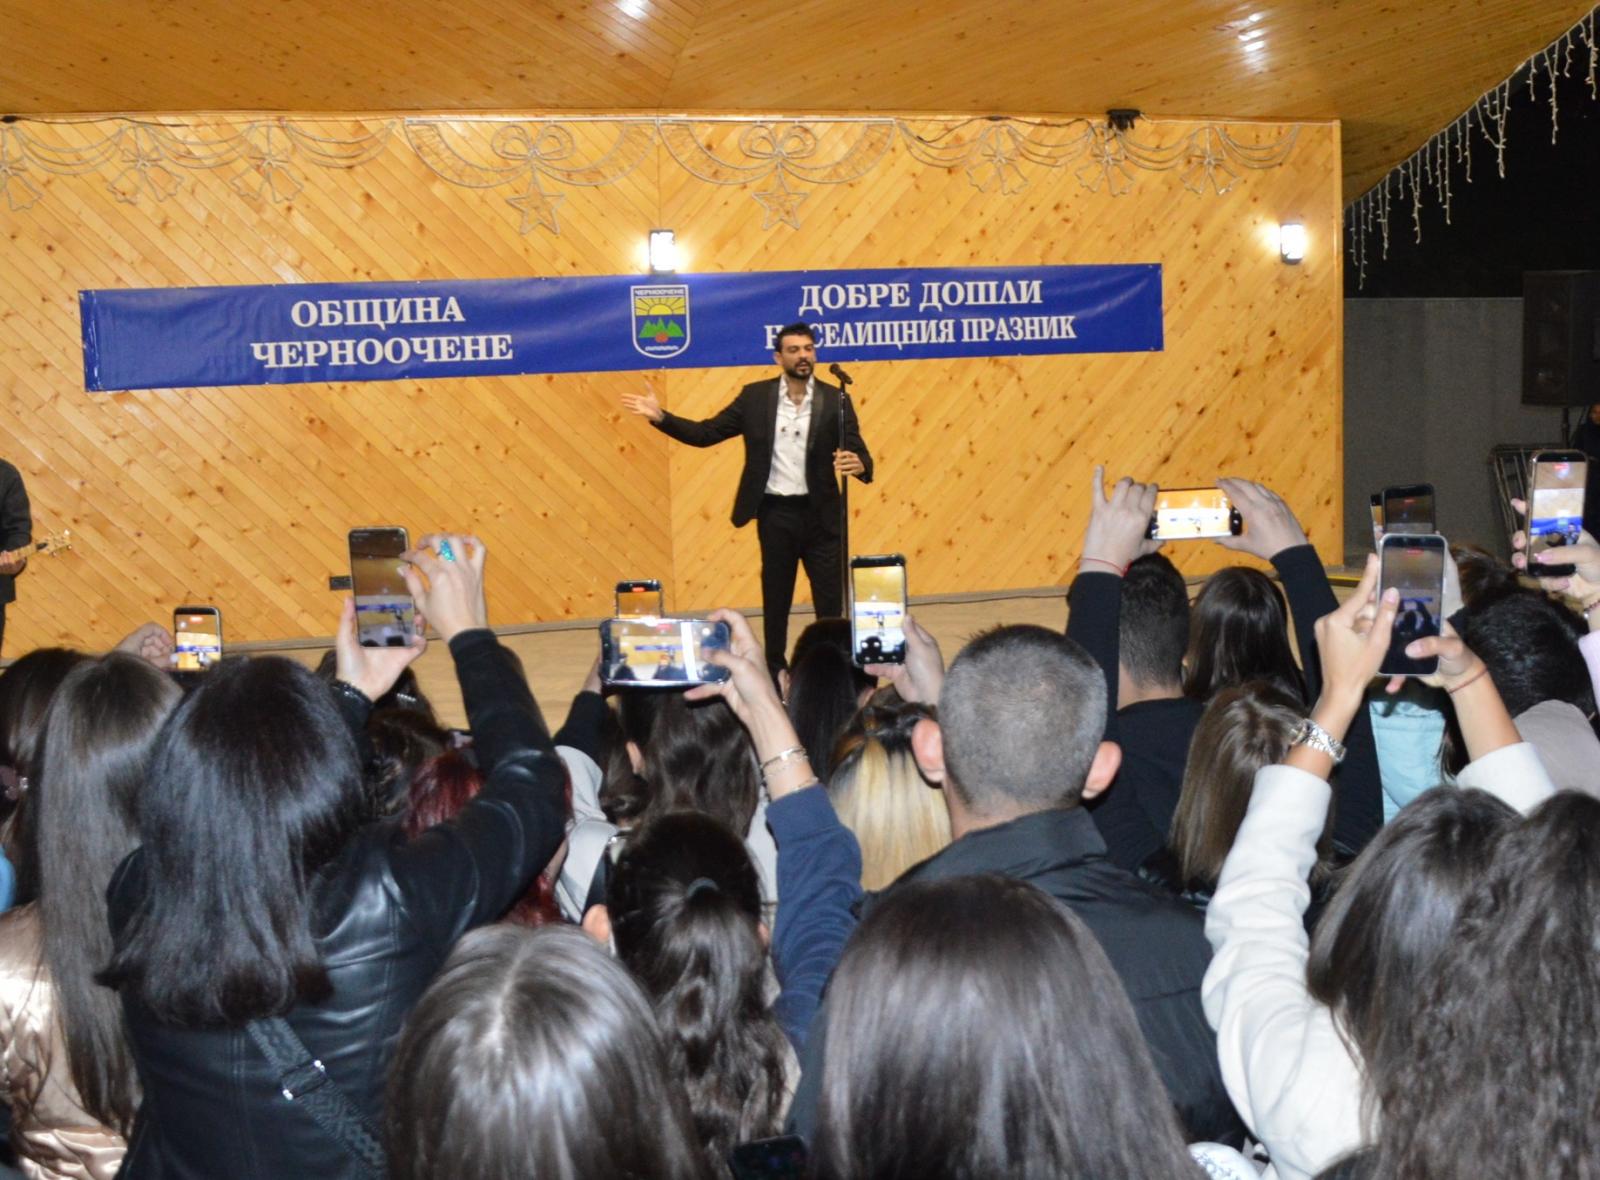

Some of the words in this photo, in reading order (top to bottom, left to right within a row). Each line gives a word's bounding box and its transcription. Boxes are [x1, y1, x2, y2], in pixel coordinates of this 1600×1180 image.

[291, 296, 466, 331] ОБЩИНА
[799, 282, 910, 316] ДОБРЕ
[919, 280, 1043, 312] ДОШЛИ
[961, 315, 1077, 342] ПРАЗНИК
[250, 334, 513, 369] ЧЕРНООЧЕНЕ
